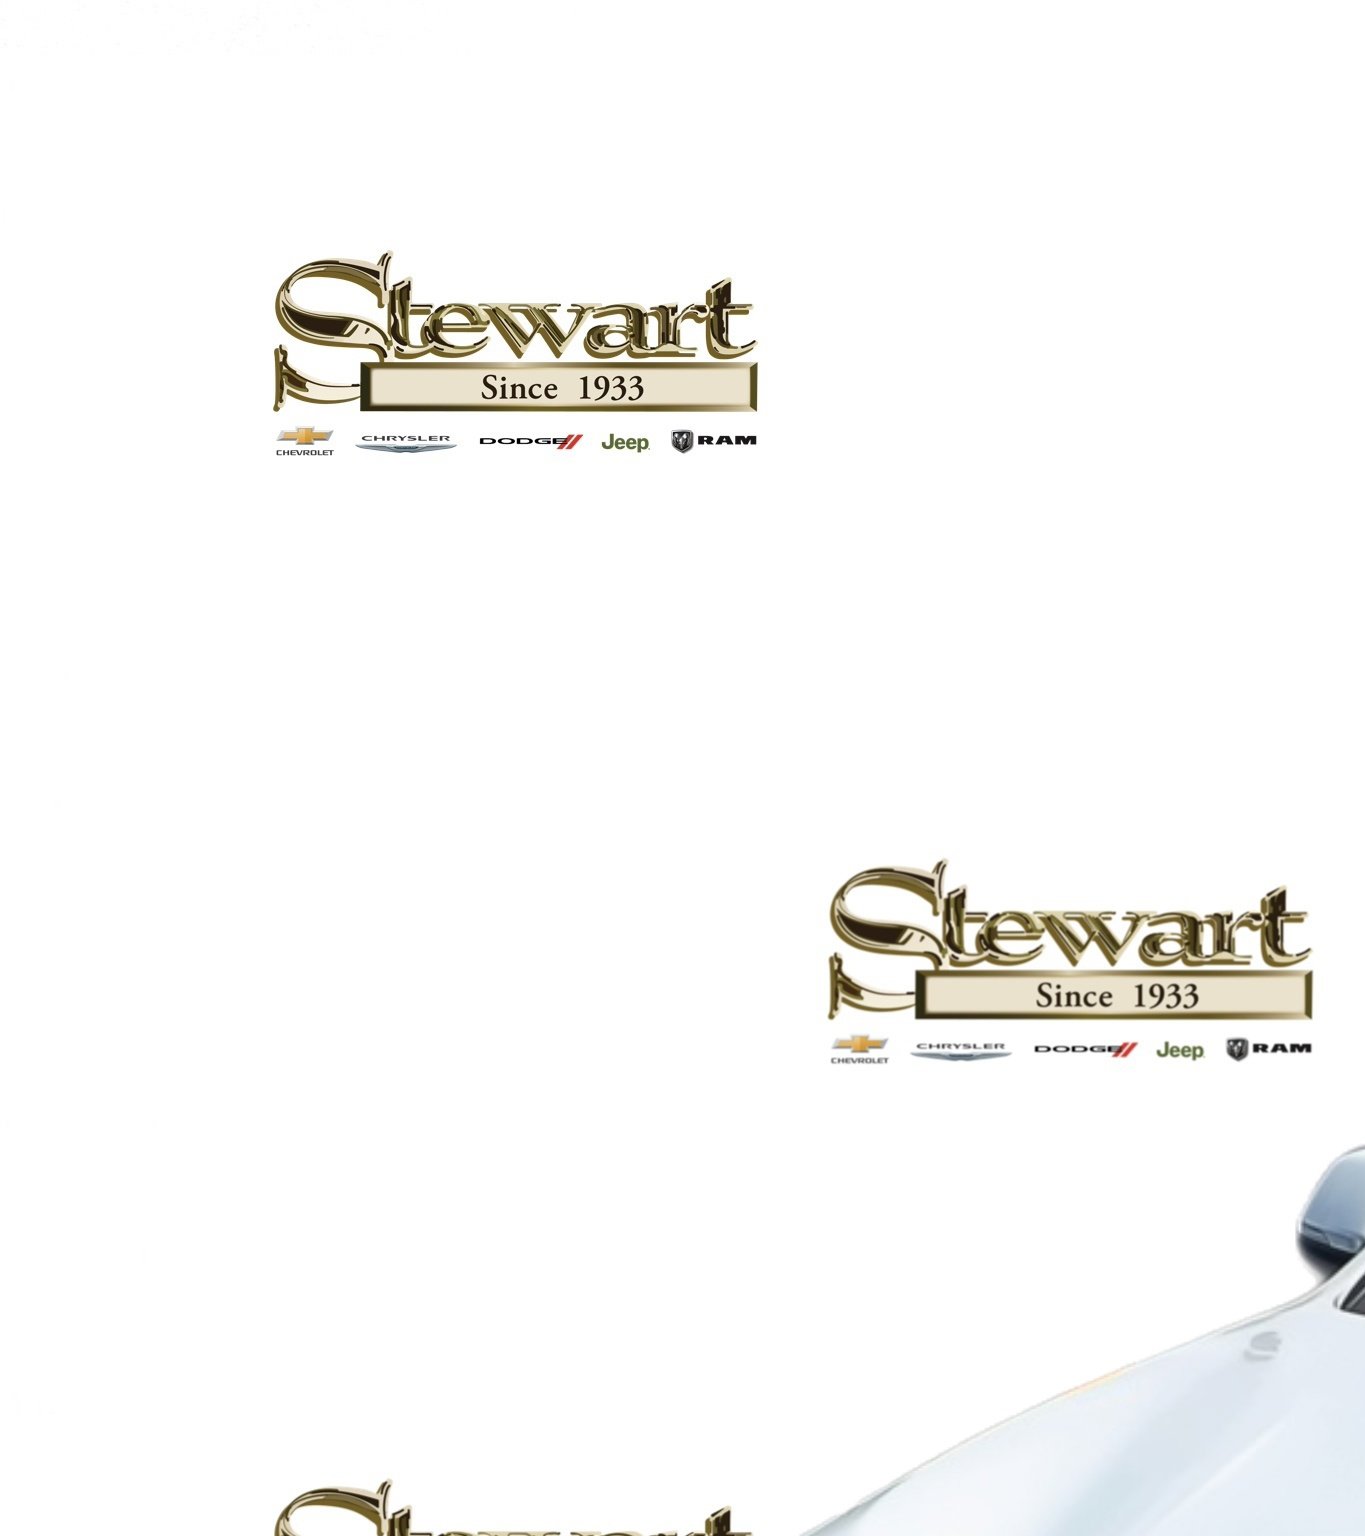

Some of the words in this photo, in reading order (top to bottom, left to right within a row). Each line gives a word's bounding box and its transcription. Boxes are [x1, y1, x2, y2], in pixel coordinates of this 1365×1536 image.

[274, 250, 757, 412] Stewart
[481, 373, 558, 400] Since
[580, 374, 645, 401] 1933
[361, 434, 451, 442] CHRYSLER
[480, 437, 568, 445] DODGE
[601, 433, 650, 454] Jeep
[697, 435, 758, 446] RAM
[829, 858, 1312, 1020] Stewart
[1036, 981, 1113, 1008] Since
[1135, 982, 1200, 1009] 1933
[916, 1042, 1006, 1050] CHRYSLER
[1035, 1045, 1123, 1053] DODGE
[1156, 1041, 1205, 1062] Jeep
[1252, 1043, 1313, 1054] RAM
